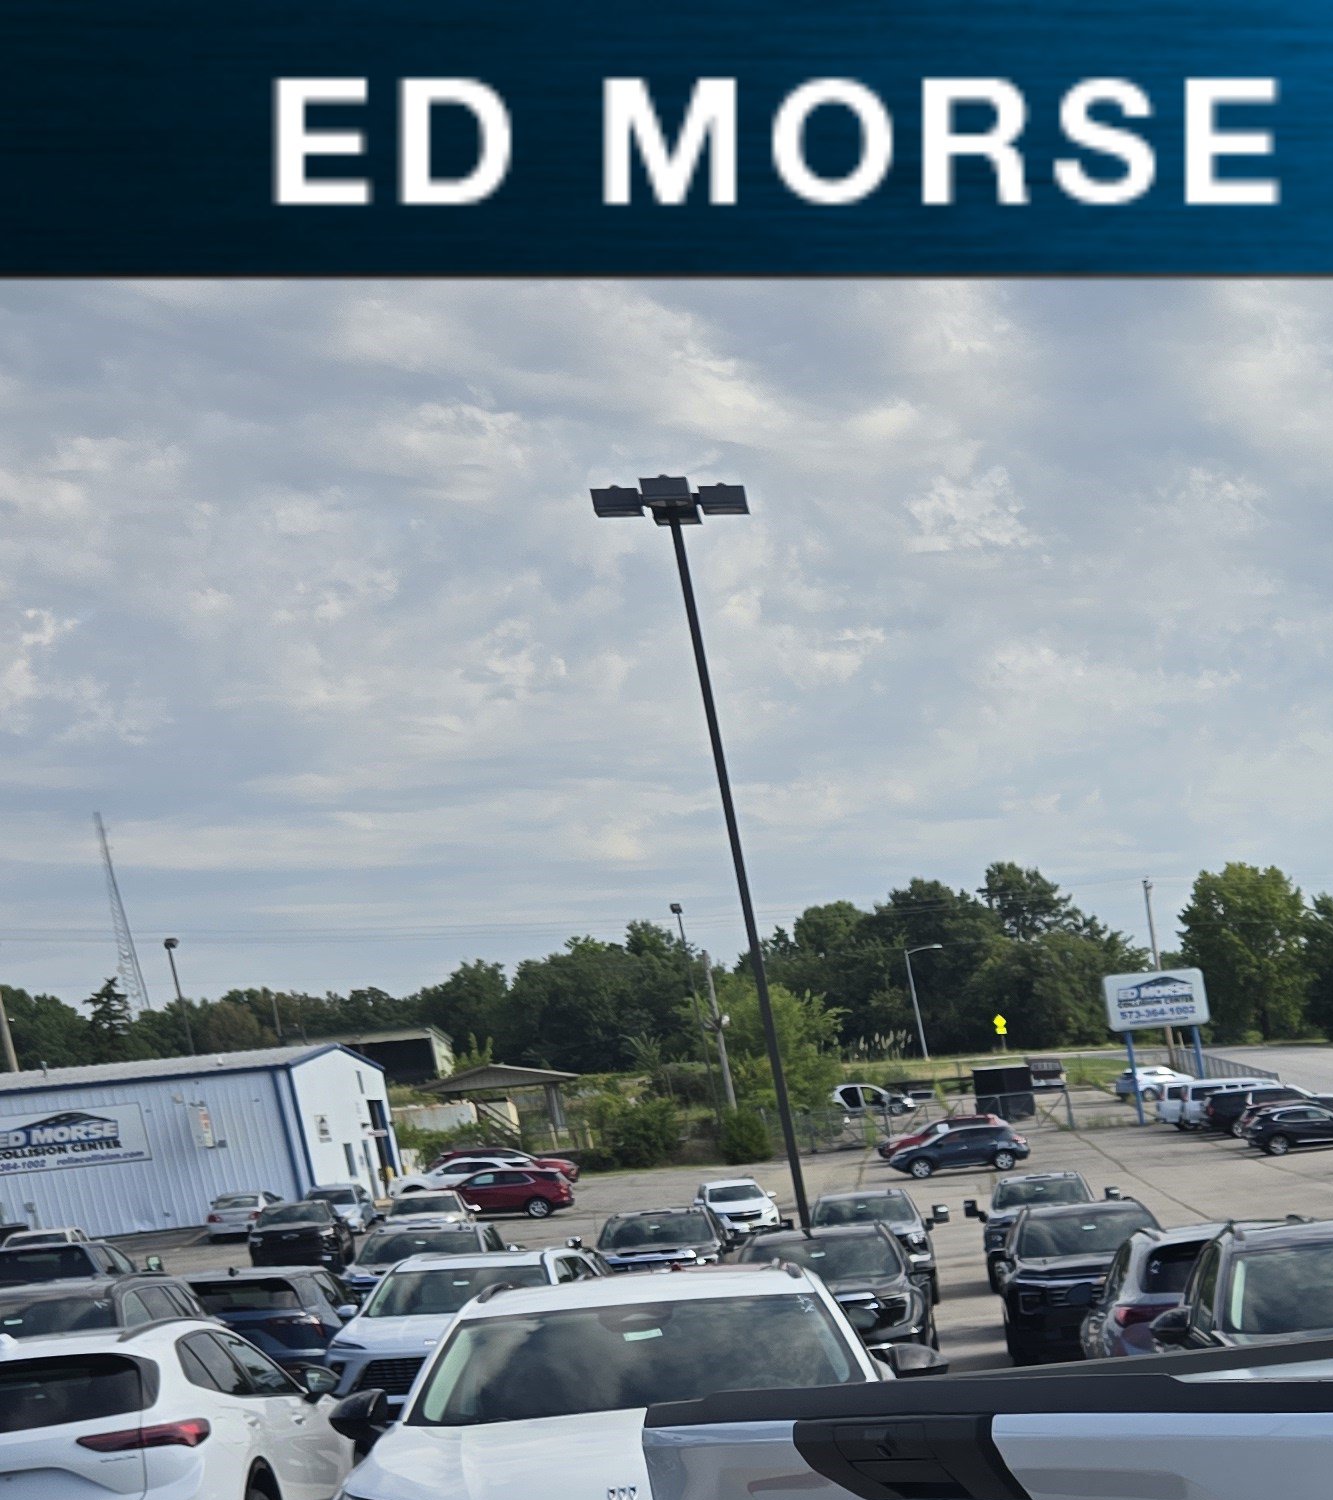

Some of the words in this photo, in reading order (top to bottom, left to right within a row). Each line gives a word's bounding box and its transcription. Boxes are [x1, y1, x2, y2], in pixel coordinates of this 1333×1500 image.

[30, 1121, 118, 1146] MORSE
[0, 1145, 69, 1161] OLLISION
[71, 1139, 122, 1153] CENTER
